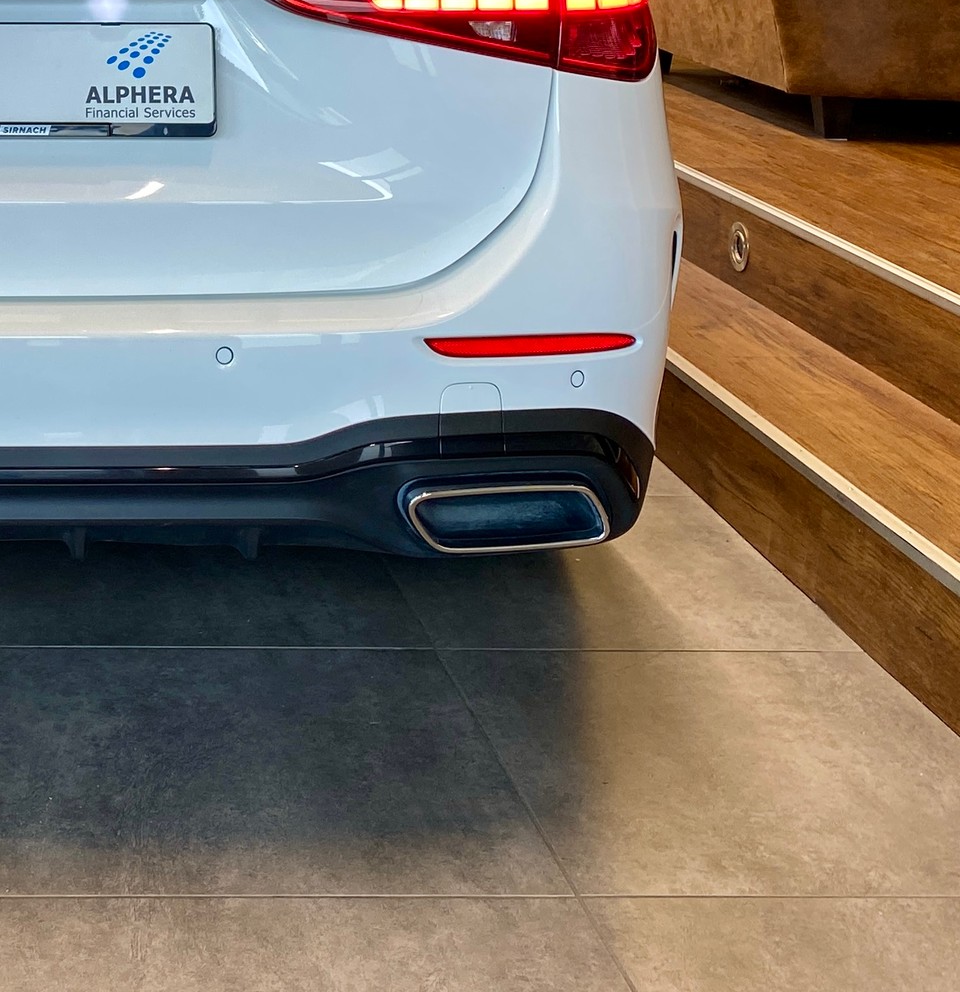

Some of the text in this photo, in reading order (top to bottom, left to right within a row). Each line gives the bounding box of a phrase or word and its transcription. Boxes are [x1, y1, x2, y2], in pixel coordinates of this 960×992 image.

[85, 86, 195, 104] ALPHERA
[85, 107, 196, 118] Financial Services
[2, 126, 47, 134] SIRNACH
